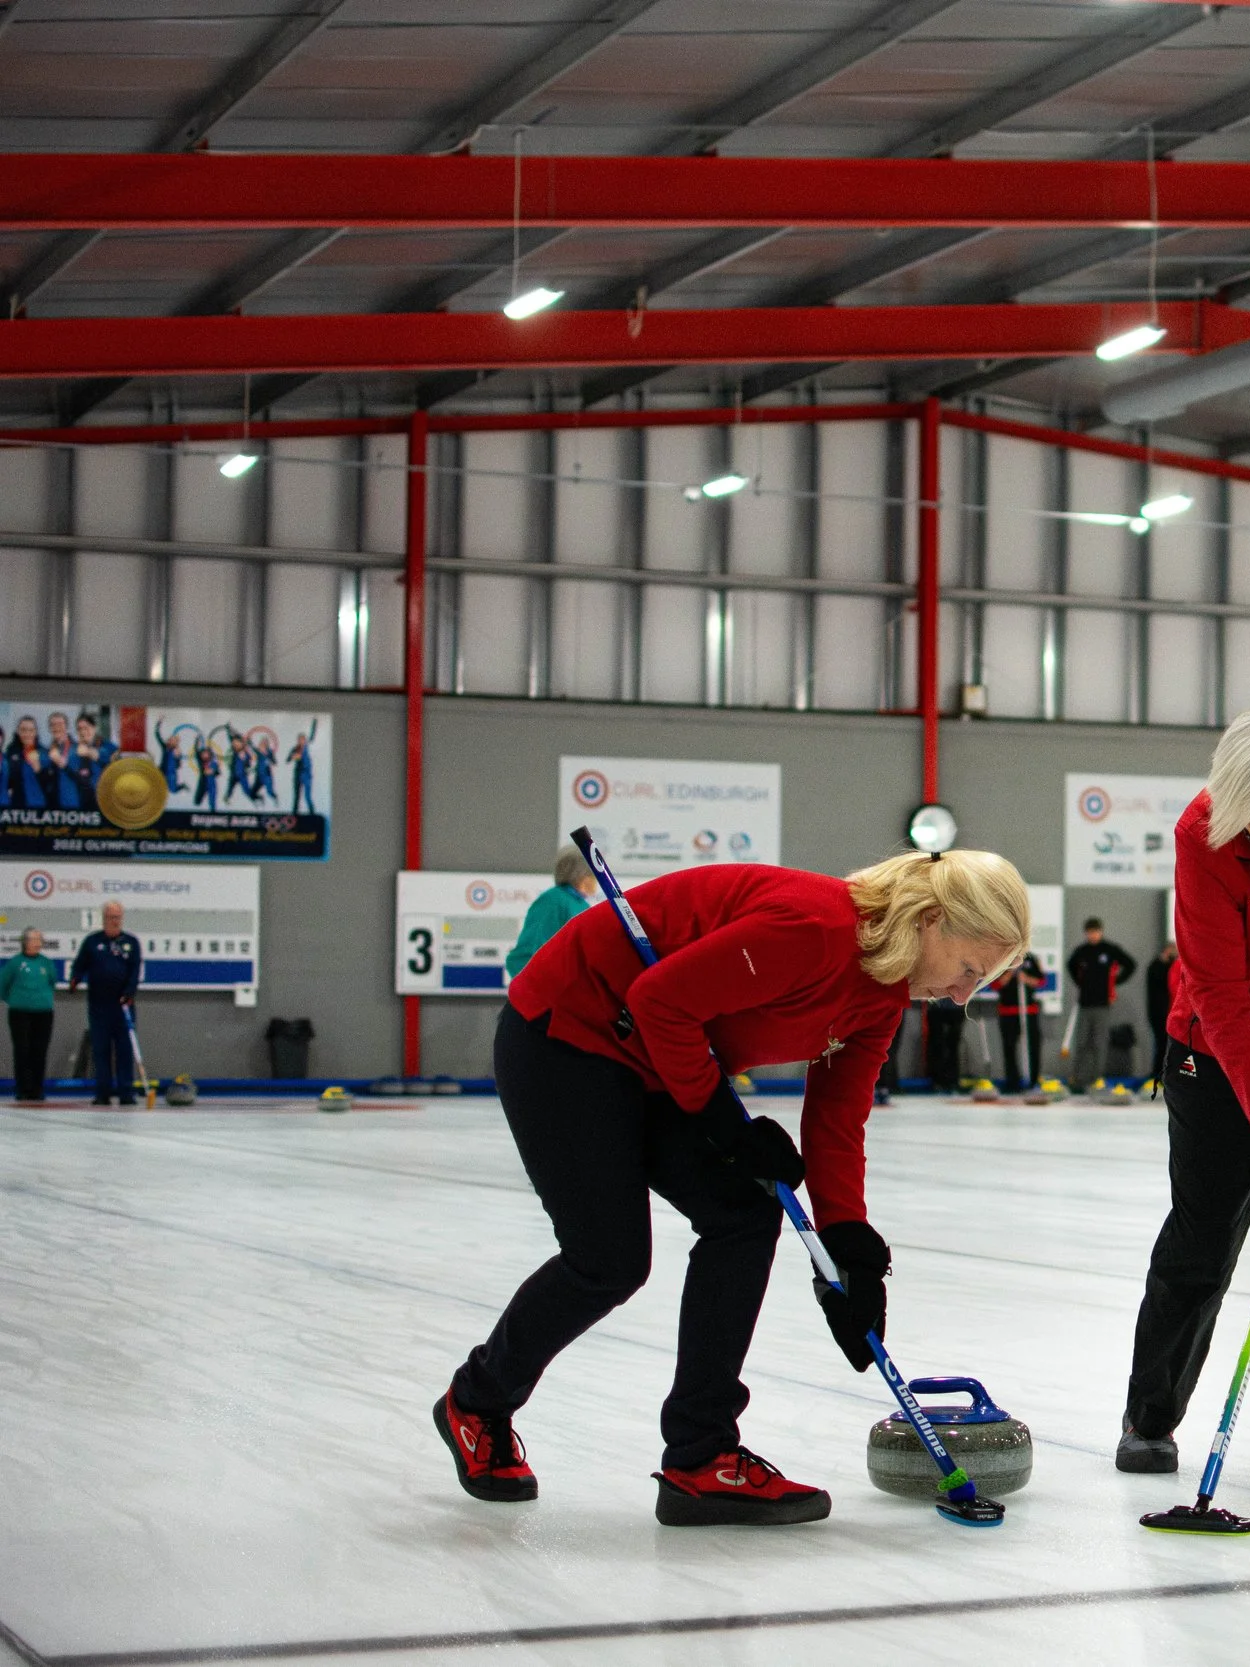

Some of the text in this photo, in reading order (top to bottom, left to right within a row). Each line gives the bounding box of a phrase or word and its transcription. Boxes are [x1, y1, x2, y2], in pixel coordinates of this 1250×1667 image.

[666, 783, 769, 801] EDINBURGH
[84, 840, 136, 851] OLYMPIC
[138, 841, 210, 853] CHAMPIONS
[57, 879, 191, 894] CURL EDINBURGH
[407, 927, 434, 975] 3
[896, 1383, 947, 1458] Goldline
